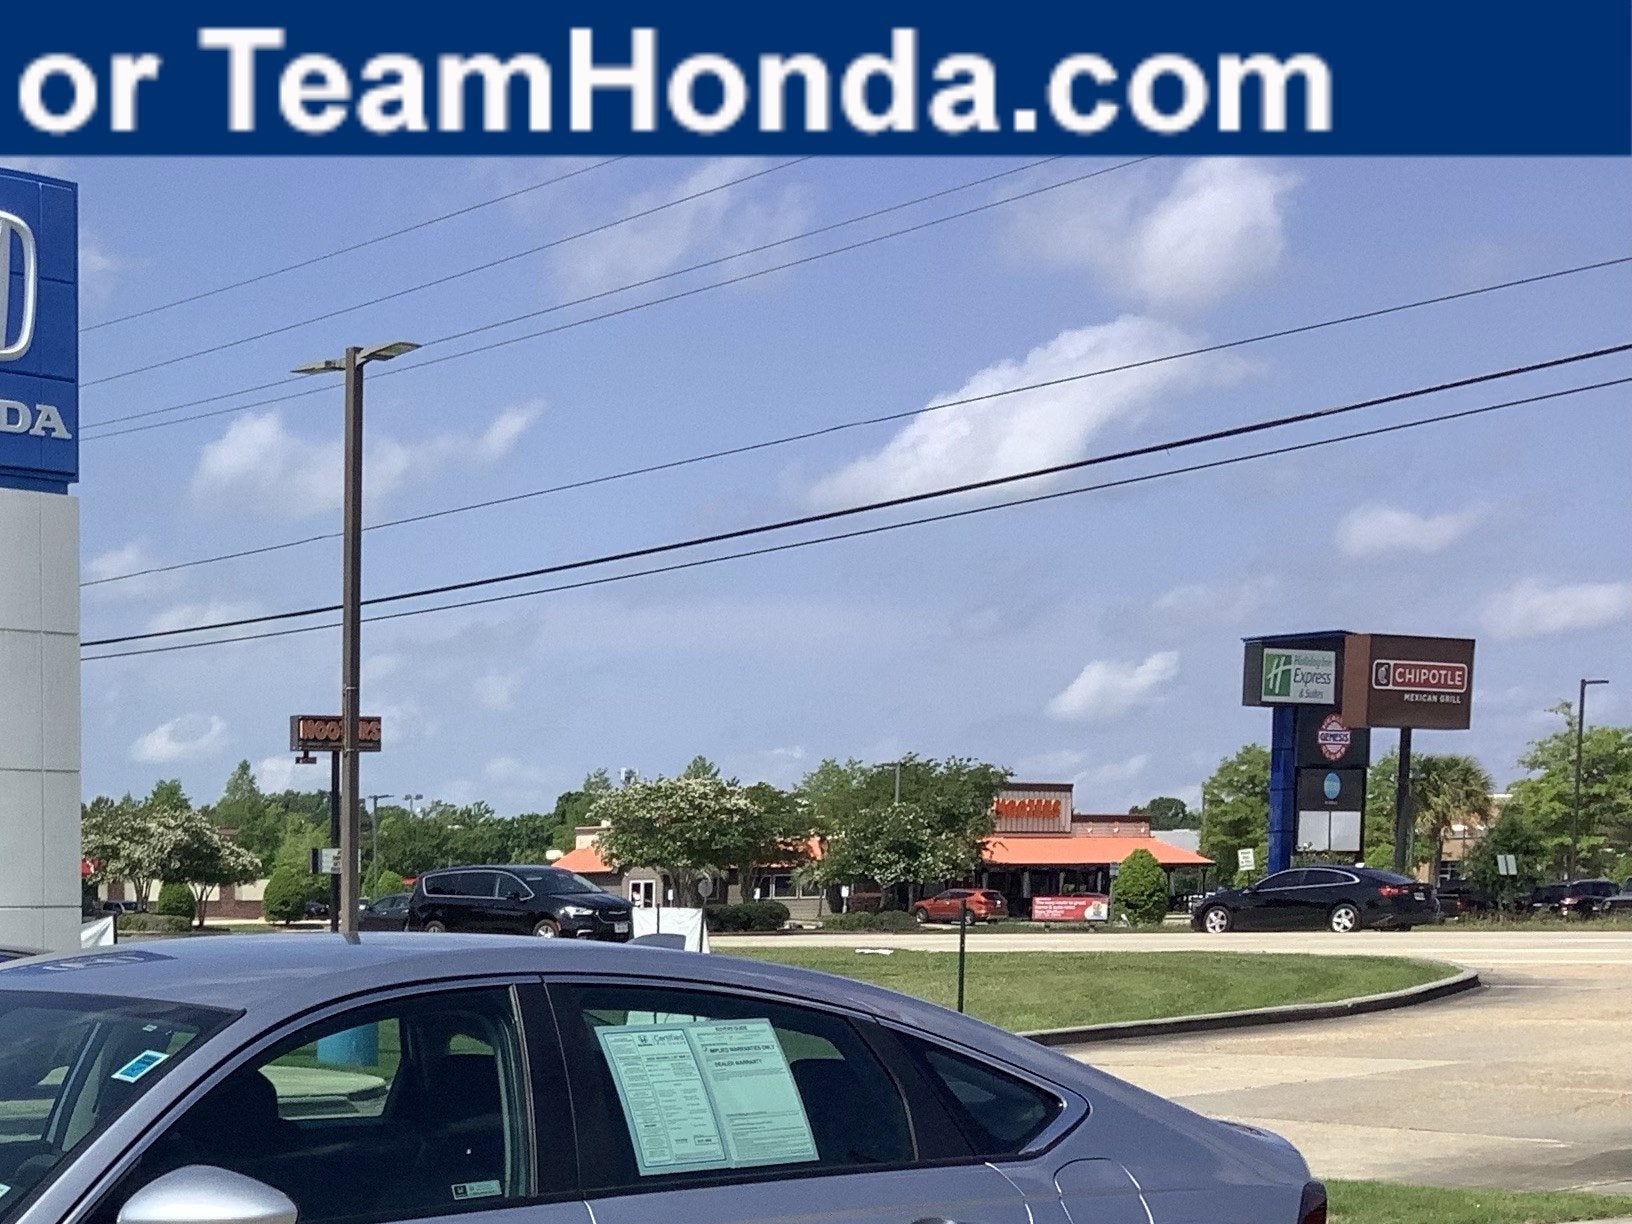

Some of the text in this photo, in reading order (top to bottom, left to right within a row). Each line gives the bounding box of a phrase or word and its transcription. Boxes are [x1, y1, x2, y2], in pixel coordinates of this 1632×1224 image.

[1293, 667, 1332, 687] Express
[1395, 668, 1463, 686] CHIPOTLE
[1403, 693, 1461, 704] MEXICAN GRILL
